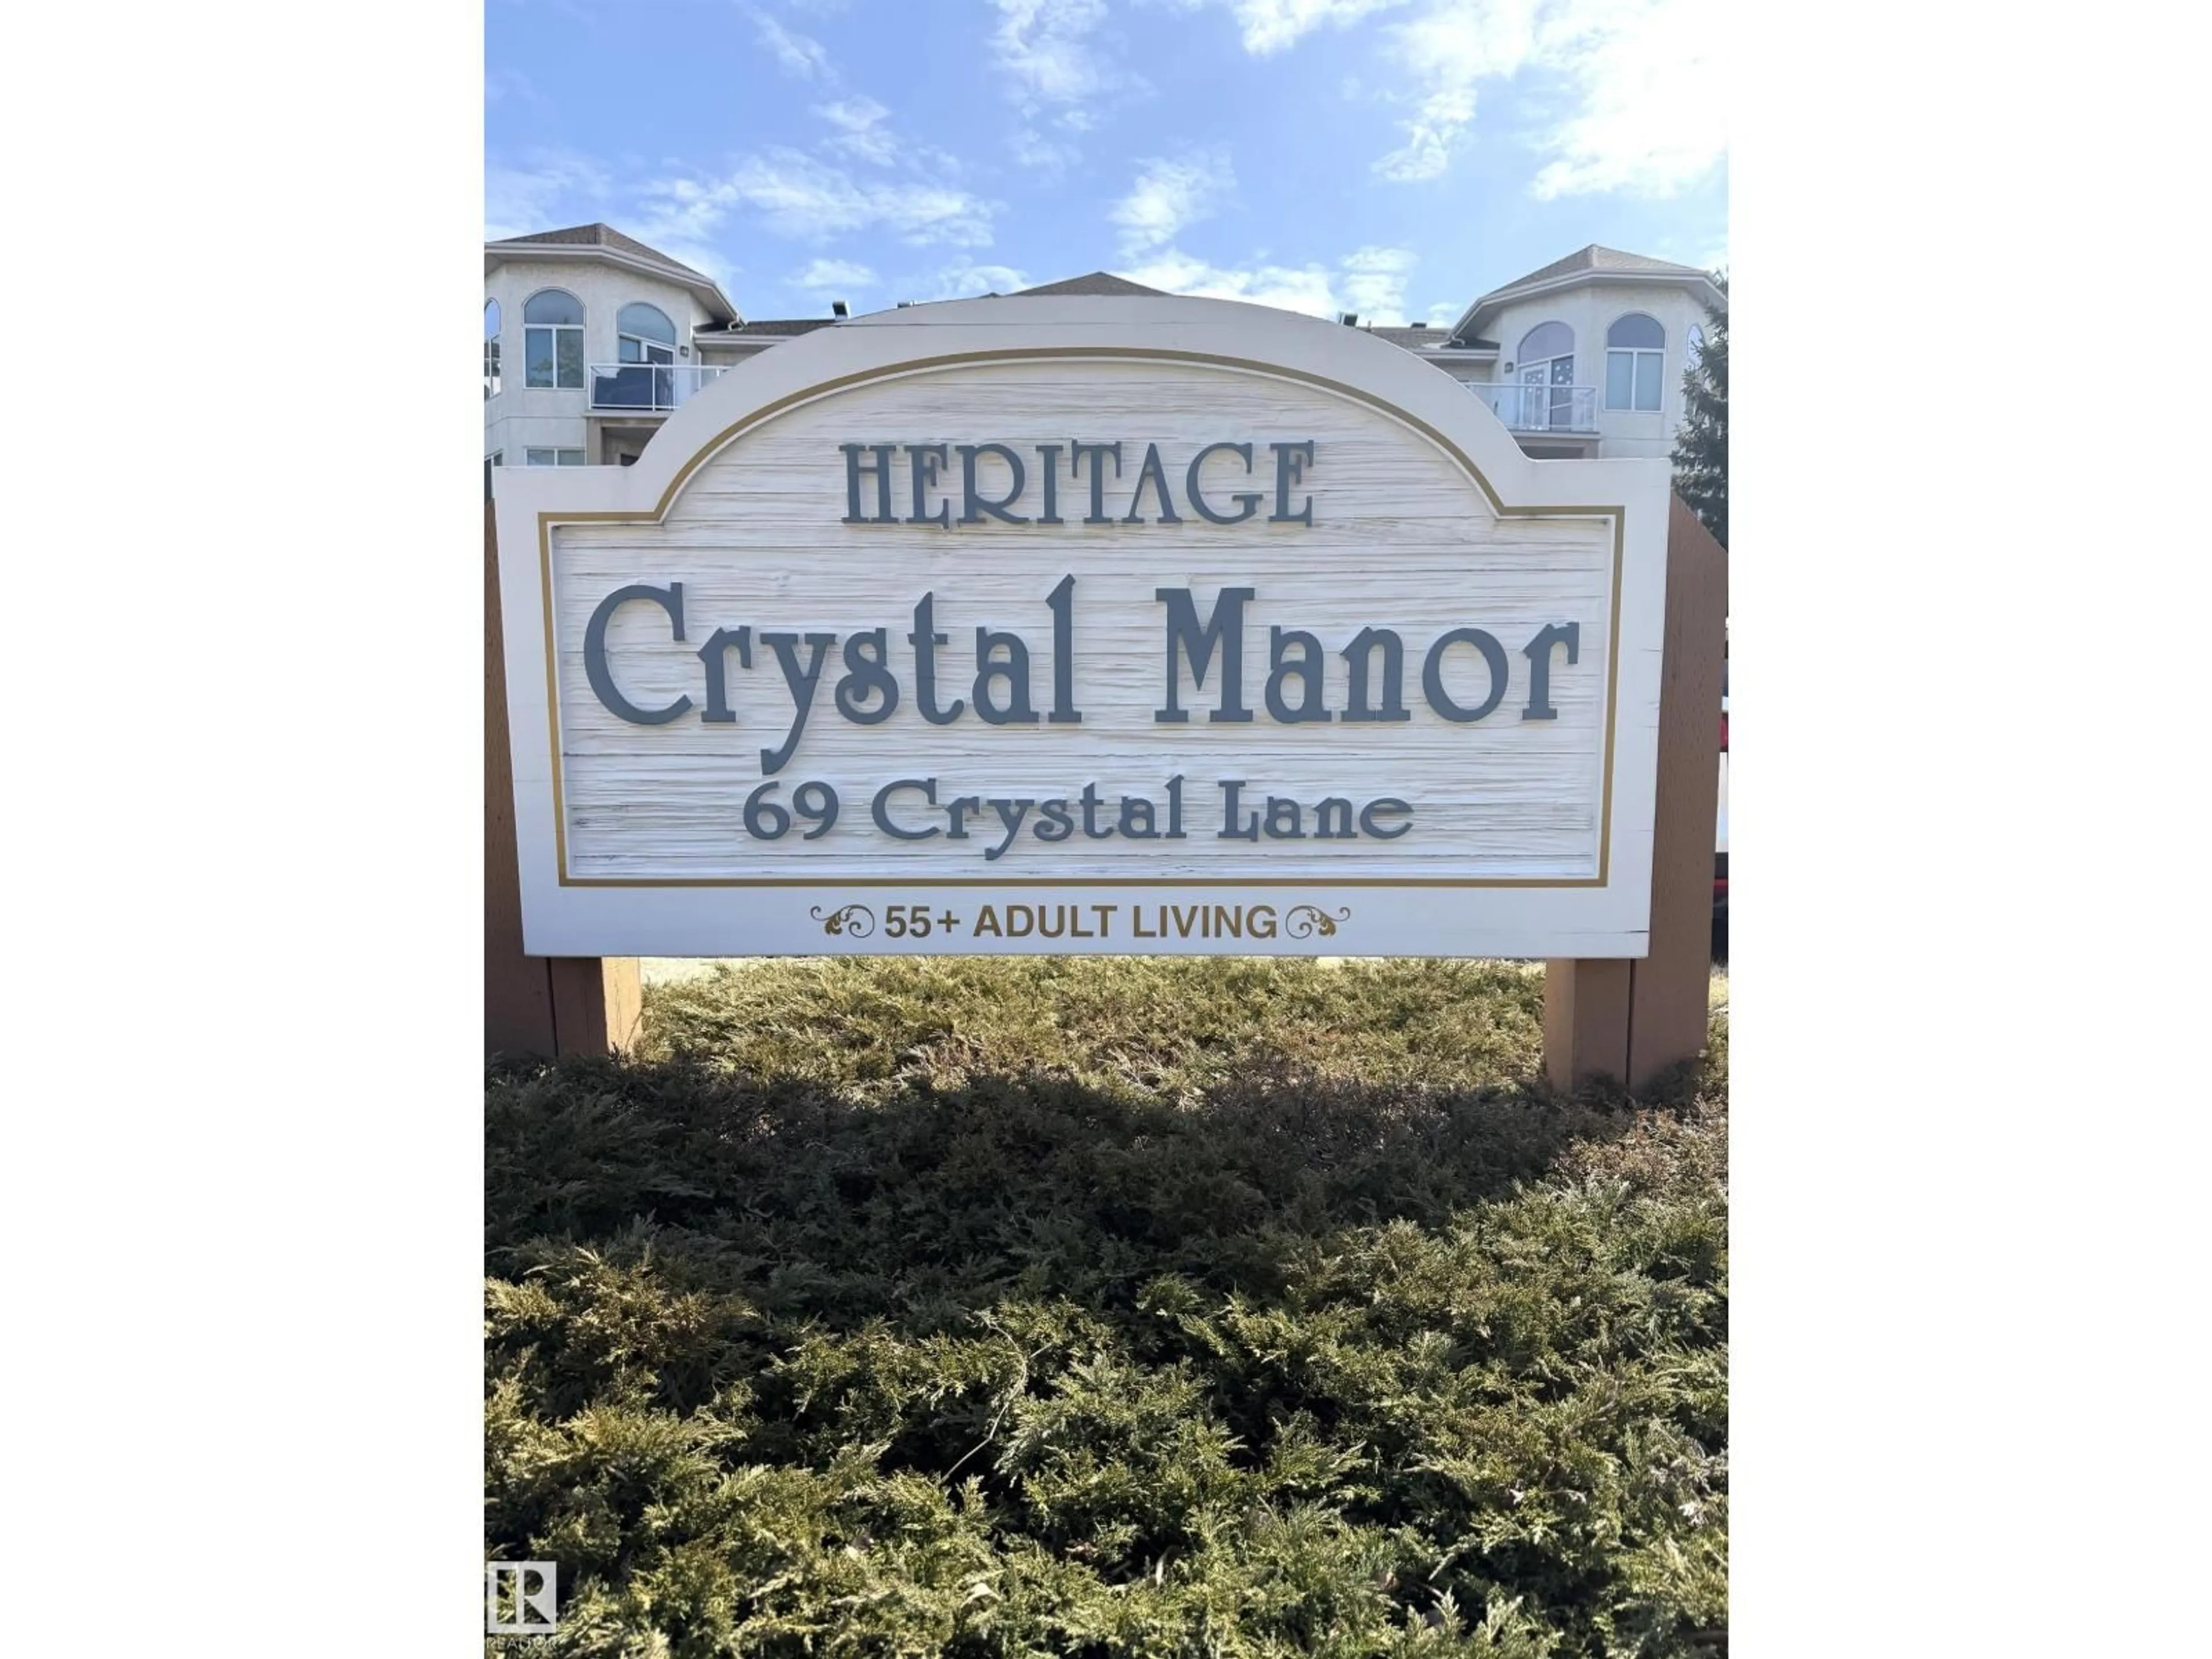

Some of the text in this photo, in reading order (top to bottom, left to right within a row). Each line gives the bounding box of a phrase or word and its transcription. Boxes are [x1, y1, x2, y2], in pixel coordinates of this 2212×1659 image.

[839, 440, 1315, 529] HERITAGE
[583, 574, 1579, 775] Crystal Manor
[743, 775, 1414, 861] 69 Crystal Lane
[885, 906, 1277, 939] 55+ ADULT LIVING
